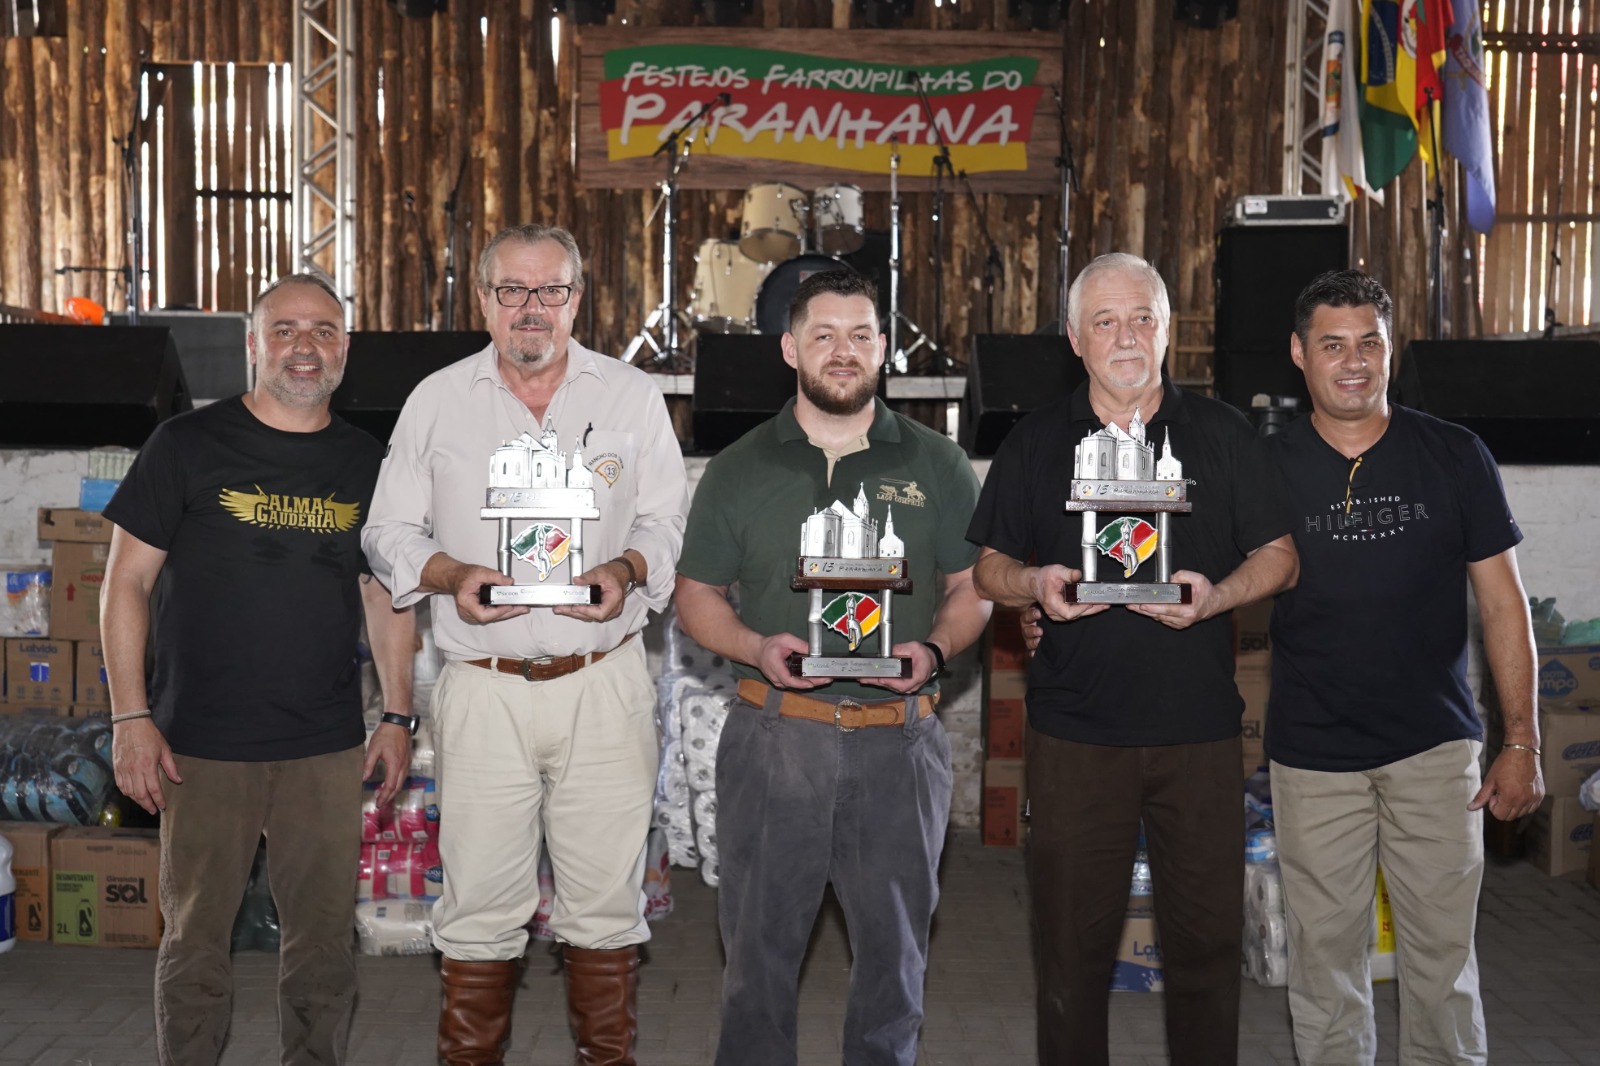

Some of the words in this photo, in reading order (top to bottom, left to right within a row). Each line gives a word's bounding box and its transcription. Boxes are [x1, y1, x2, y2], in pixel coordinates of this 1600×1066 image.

[621, 61, 750, 92] FESTEJOS
[761, 64, 974, 95] FARROUPILHAS
[982, 70, 1023, 91] DO
[619, 92, 1020, 150] PARANHANA
[607, 467, 616, 476] 13
[267, 493, 325, 515] ALMA
[1330, 495, 1401, 511] ESTABISHED
[256, 503, 337, 529] GAUDERIA
[1305, 503, 1430, 532] HILFIGER
[1332, 525, 1405, 541] MCMLXXXV
[105, 877, 148, 904] sol
[56, 923, 69, 935] 2L
